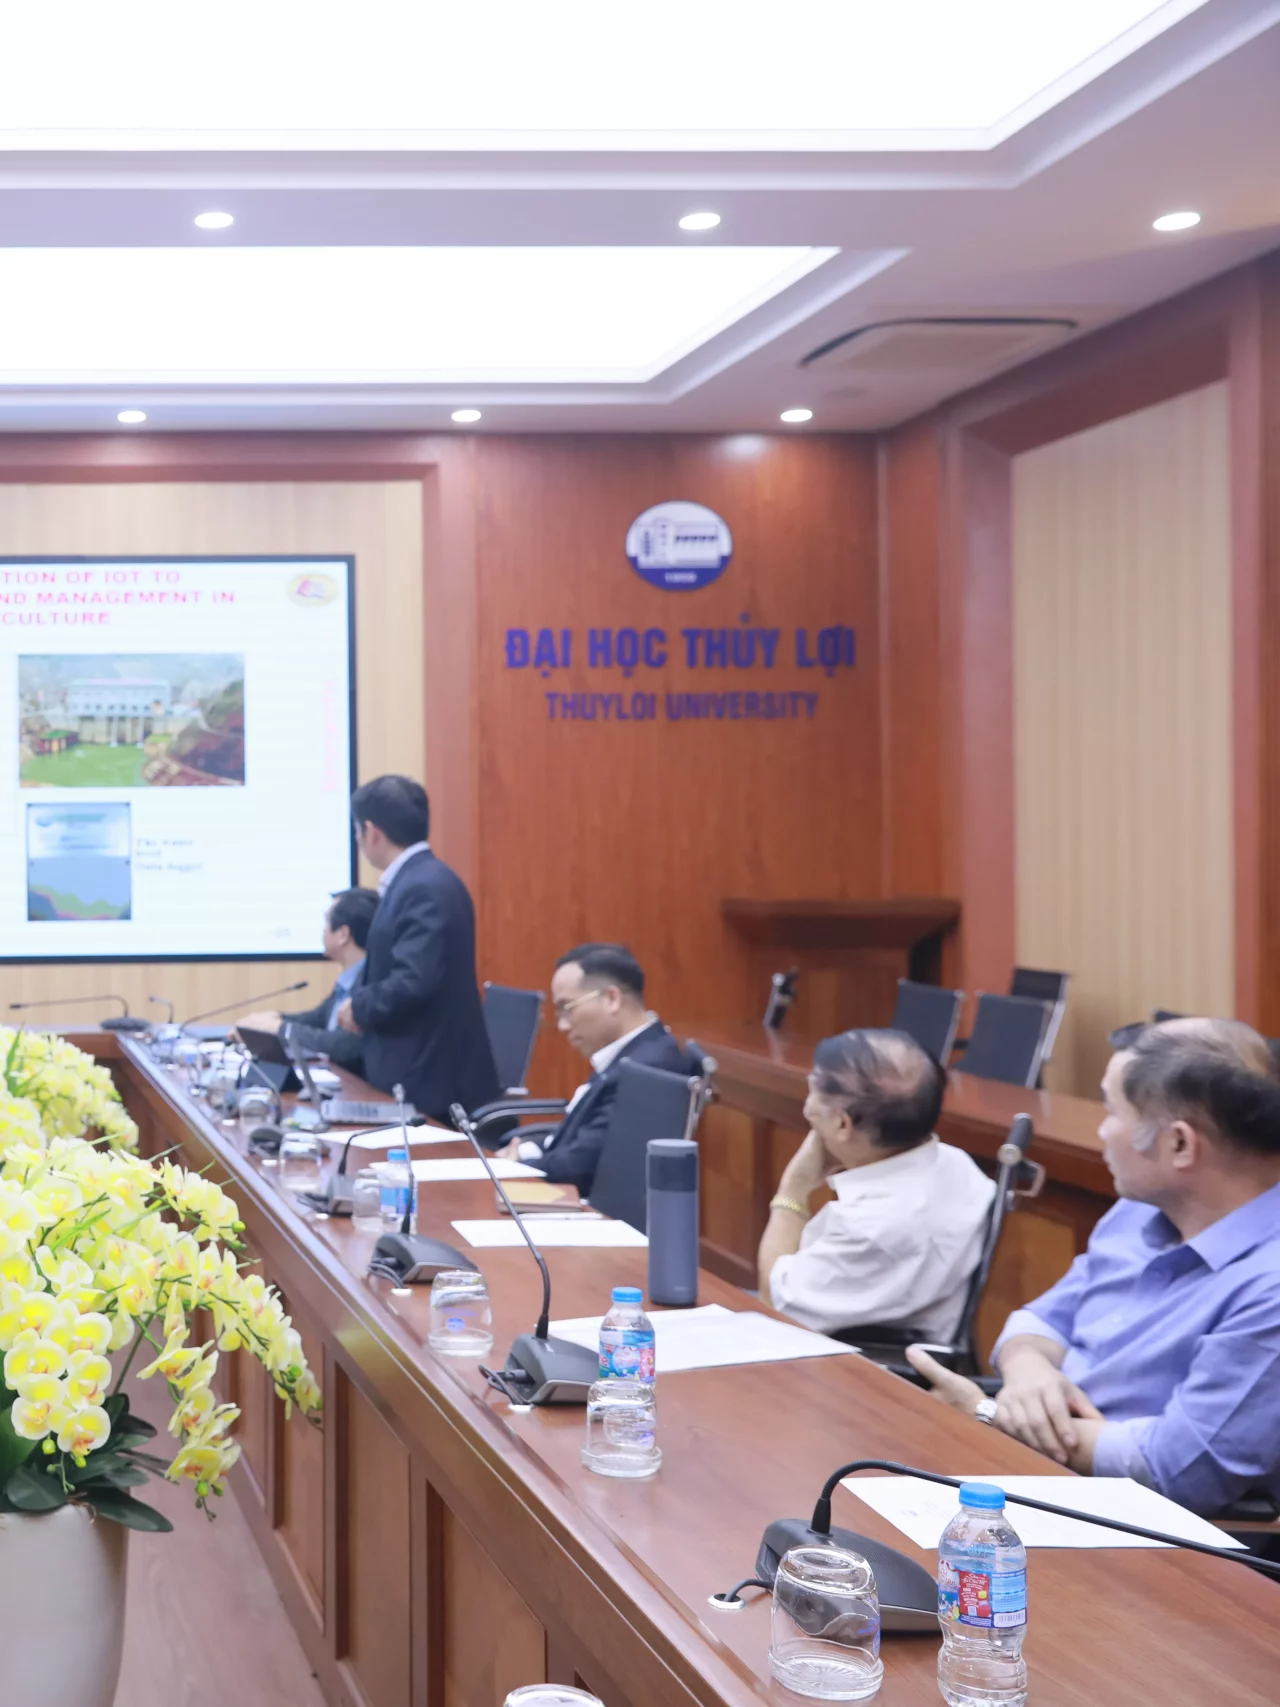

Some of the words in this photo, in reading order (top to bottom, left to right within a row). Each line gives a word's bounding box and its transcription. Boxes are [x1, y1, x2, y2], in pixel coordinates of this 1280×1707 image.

[66, 571, 93, 585] OF
[105, 571, 140, 585] IOT
[153, 571, 180, 584] TO
[36, 591, 201, 605] MANAGEMENT
[212, 591, 235, 604] IN
[504, 628, 572, 679] ĐẠI
[588, 628, 668, 679] HỌC
[680, 612, 781, 669] THỦY
[795, 624, 856, 679] LỢI
[544, 691, 658, 721] THUYLOI
[665, 691, 819, 721] UNIVERSITY
